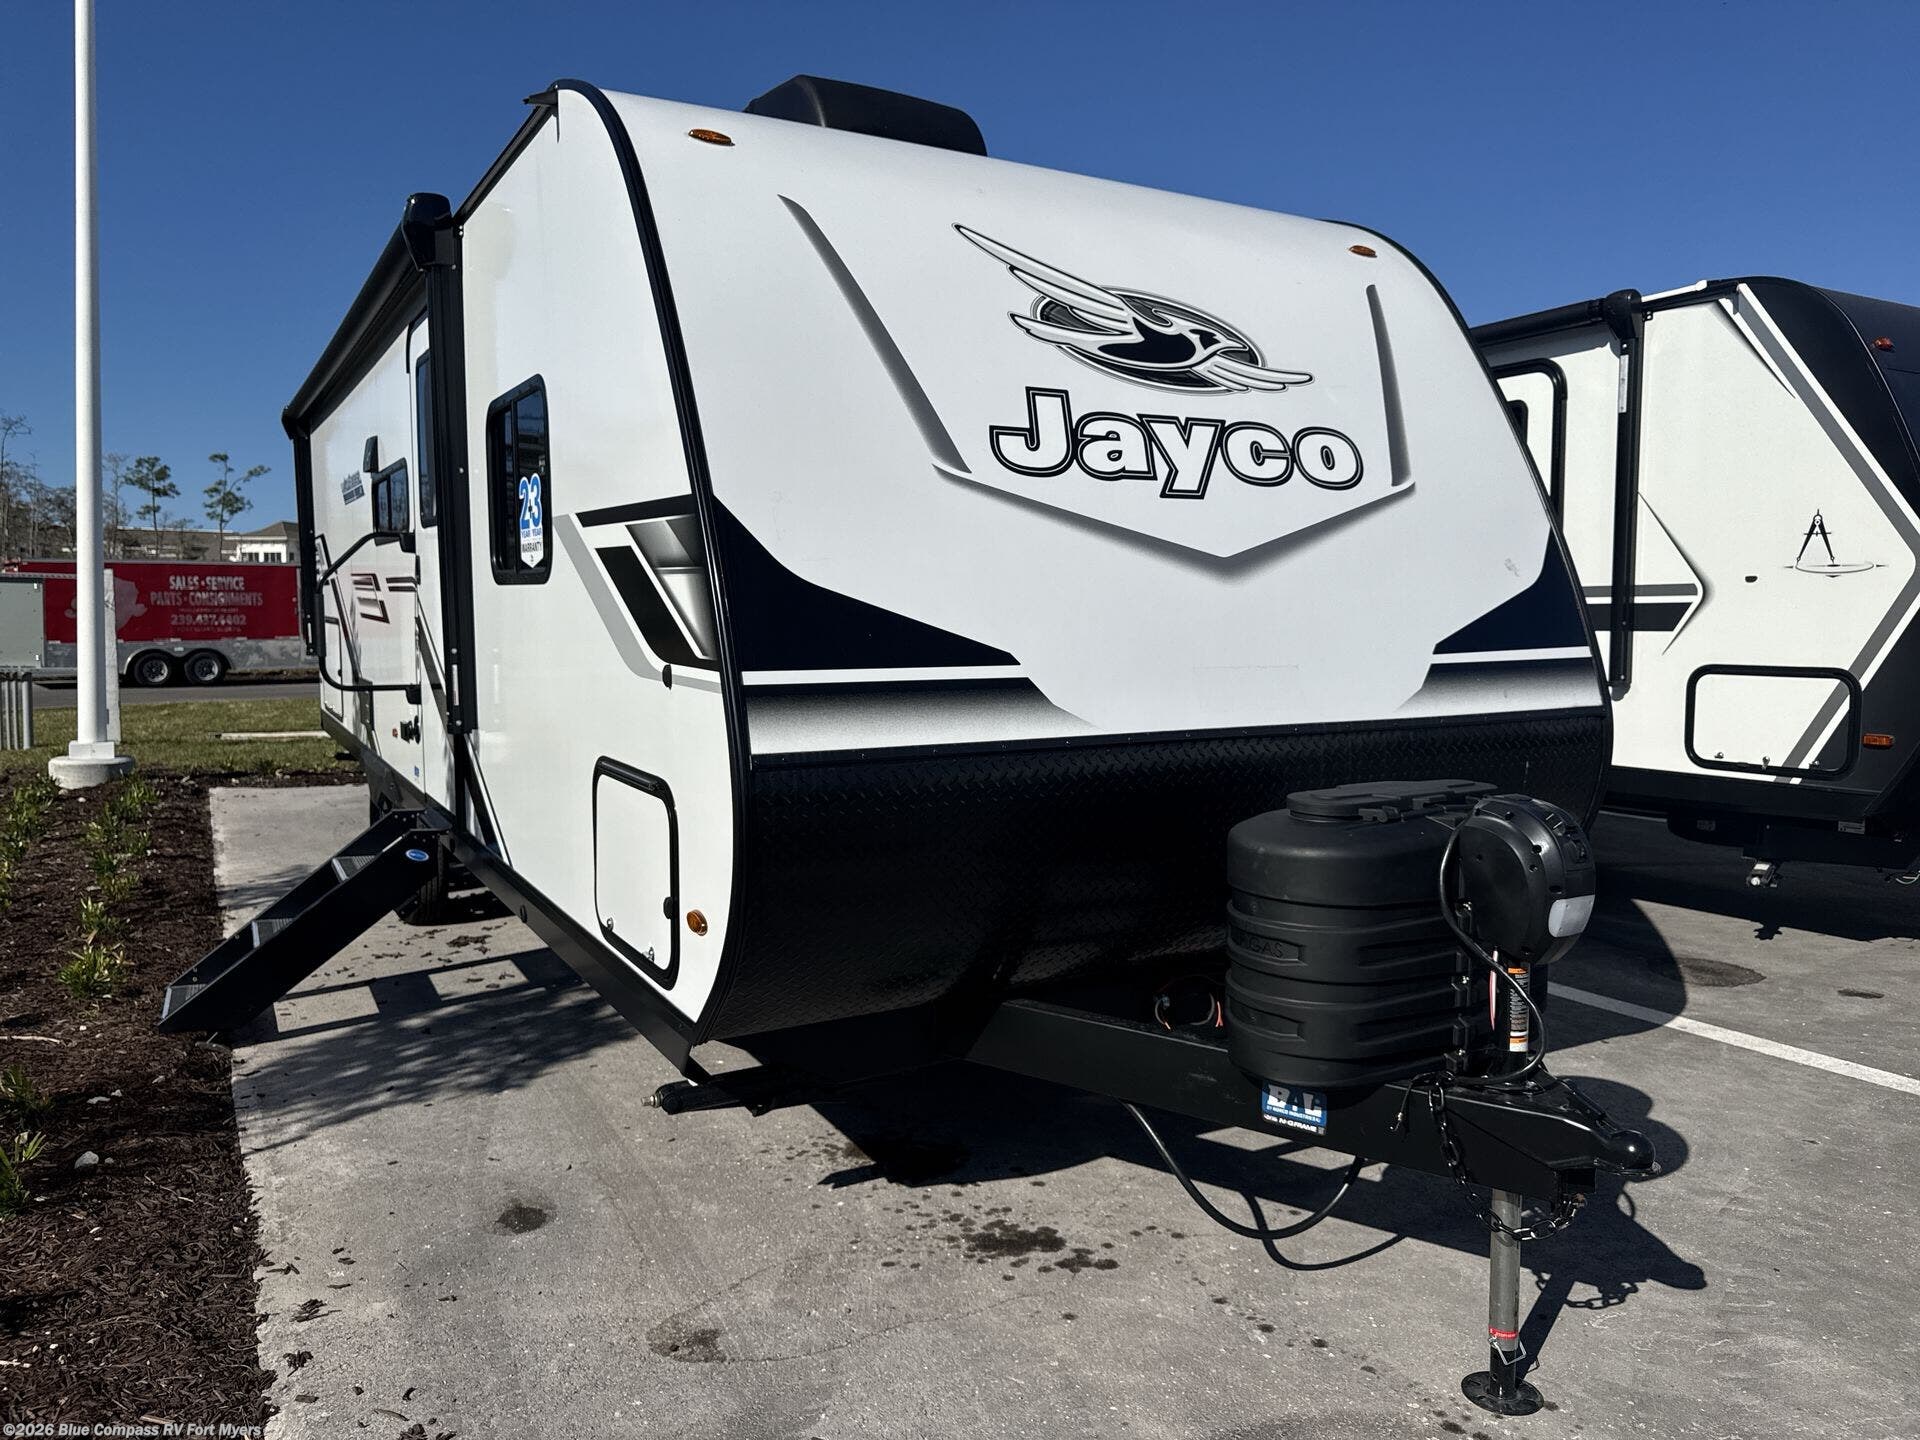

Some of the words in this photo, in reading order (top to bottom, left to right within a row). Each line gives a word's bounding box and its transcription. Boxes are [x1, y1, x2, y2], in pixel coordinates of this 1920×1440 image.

[989, 386, 1364, 499] Jayco
[521, 542, 543, 553] WARRANTY
[169, 575, 199, 591] SALES
[205, 575, 245, 591] SERVICE
[150, 591, 182, 606] PARTS
[188, 591, 263, 606] CONSIGNMENTS
